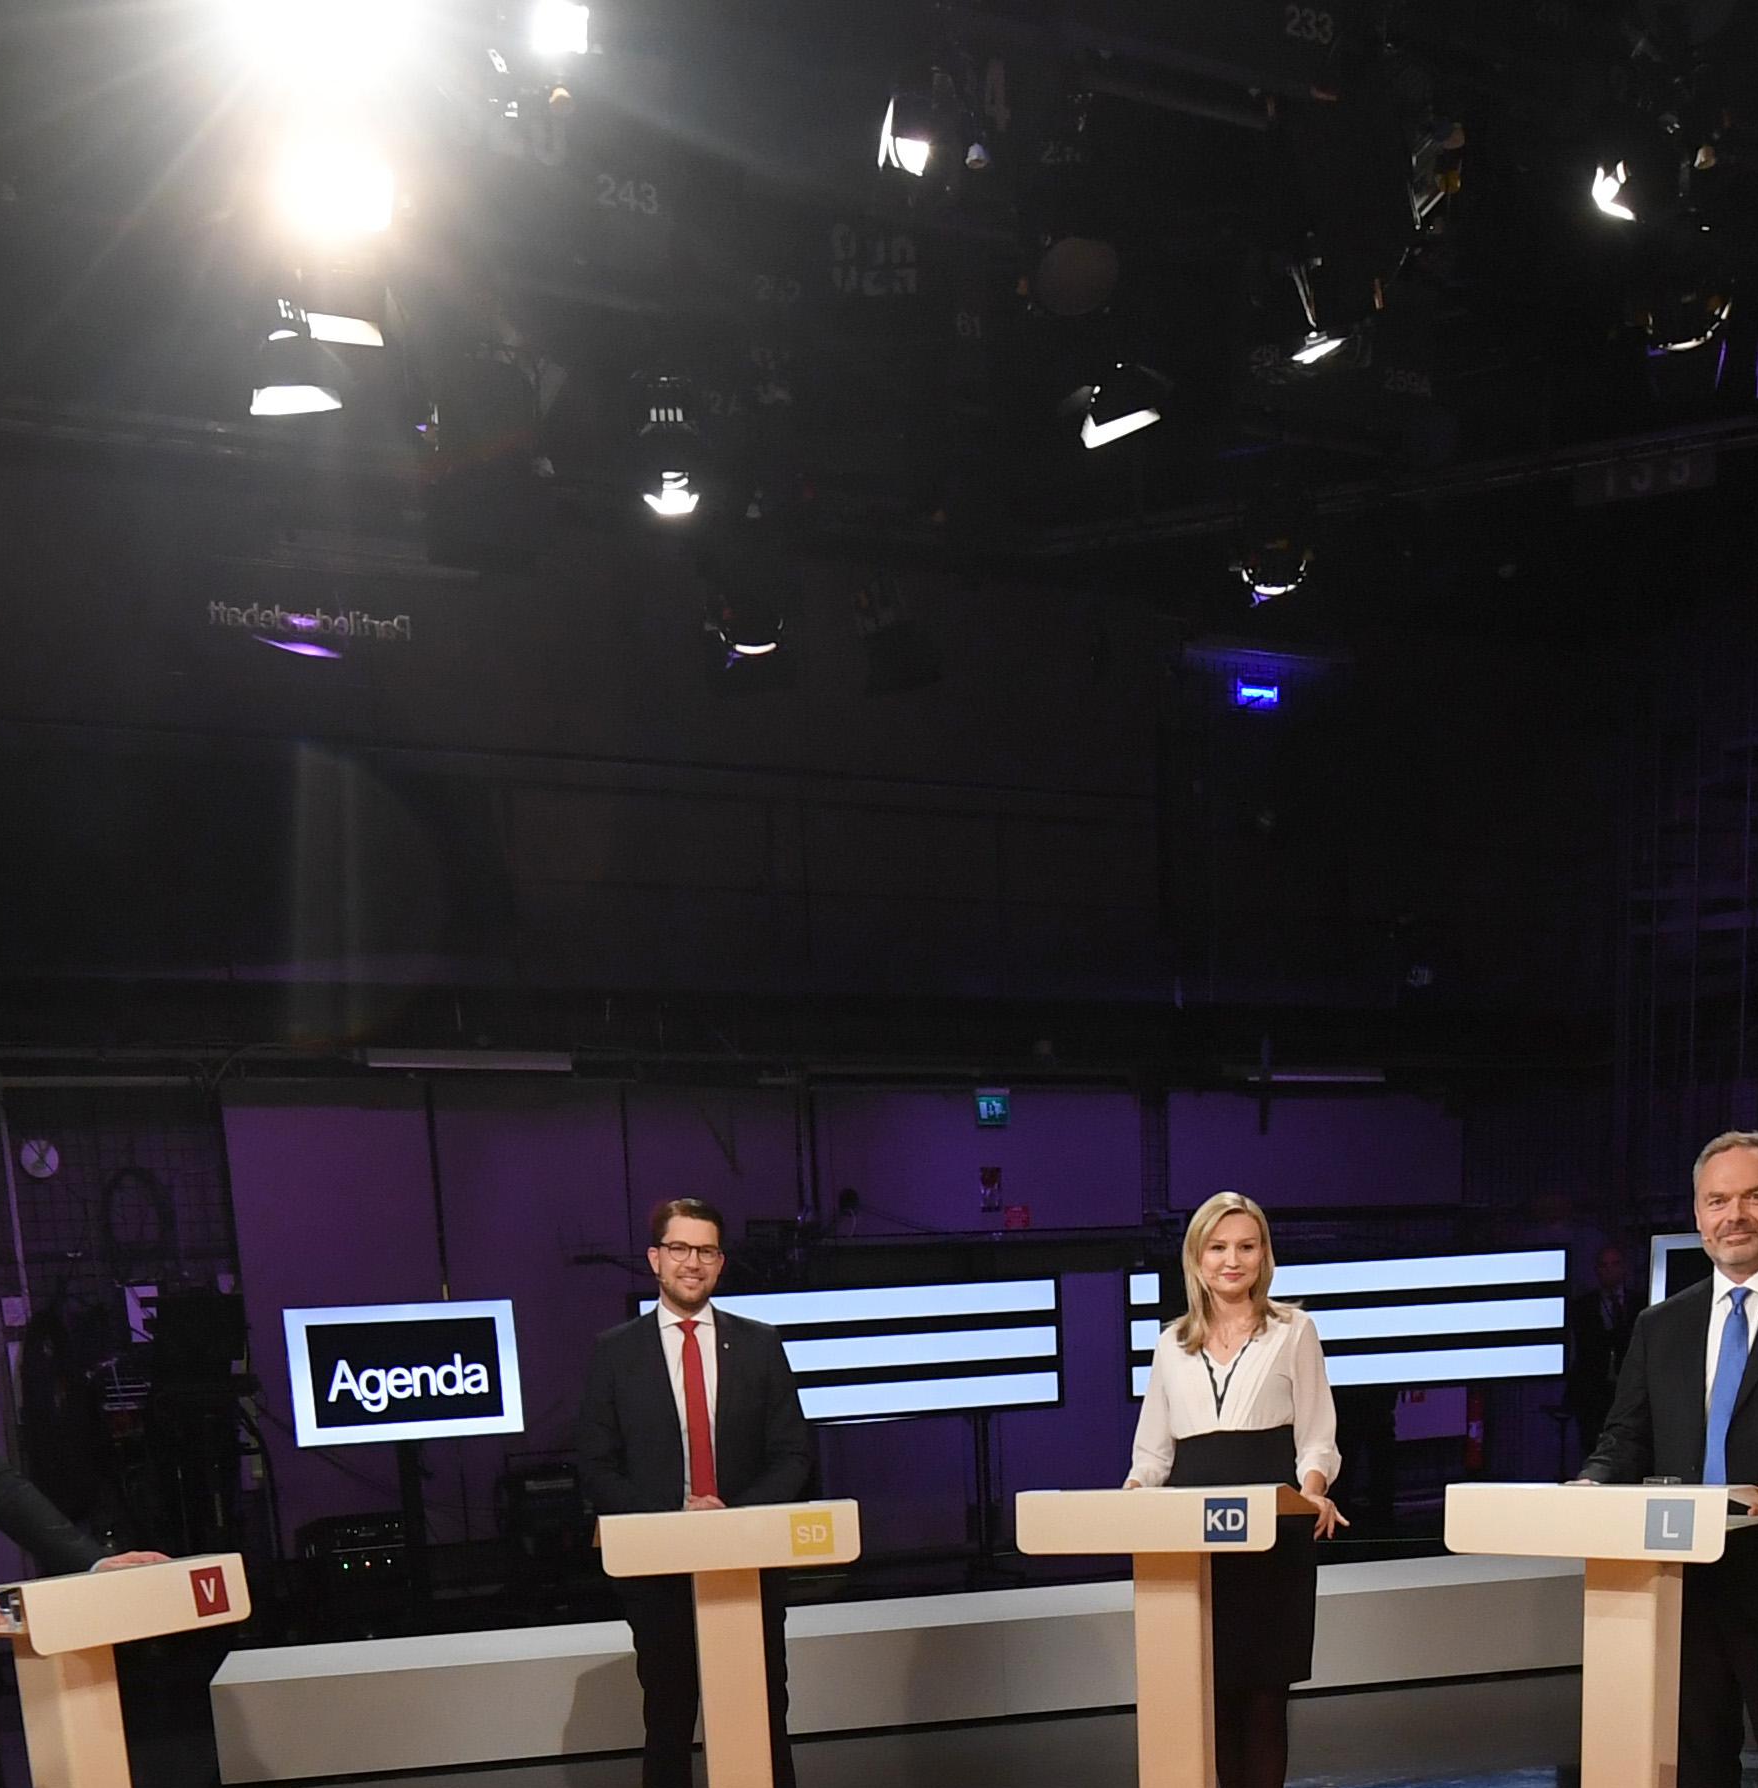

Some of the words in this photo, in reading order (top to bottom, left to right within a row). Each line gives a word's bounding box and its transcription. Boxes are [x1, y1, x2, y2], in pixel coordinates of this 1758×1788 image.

[1285, 3, 1334, 45] 233
[597, 173, 659, 216] 243
[327, 1352, 490, 1413] Agenda
[1206, 1508, 1245, 1532] KD
[1662, 1510, 1680, 1538] L
[796, 1525, 827, 1544] SD
[199, 1577, 216, 1603] V
